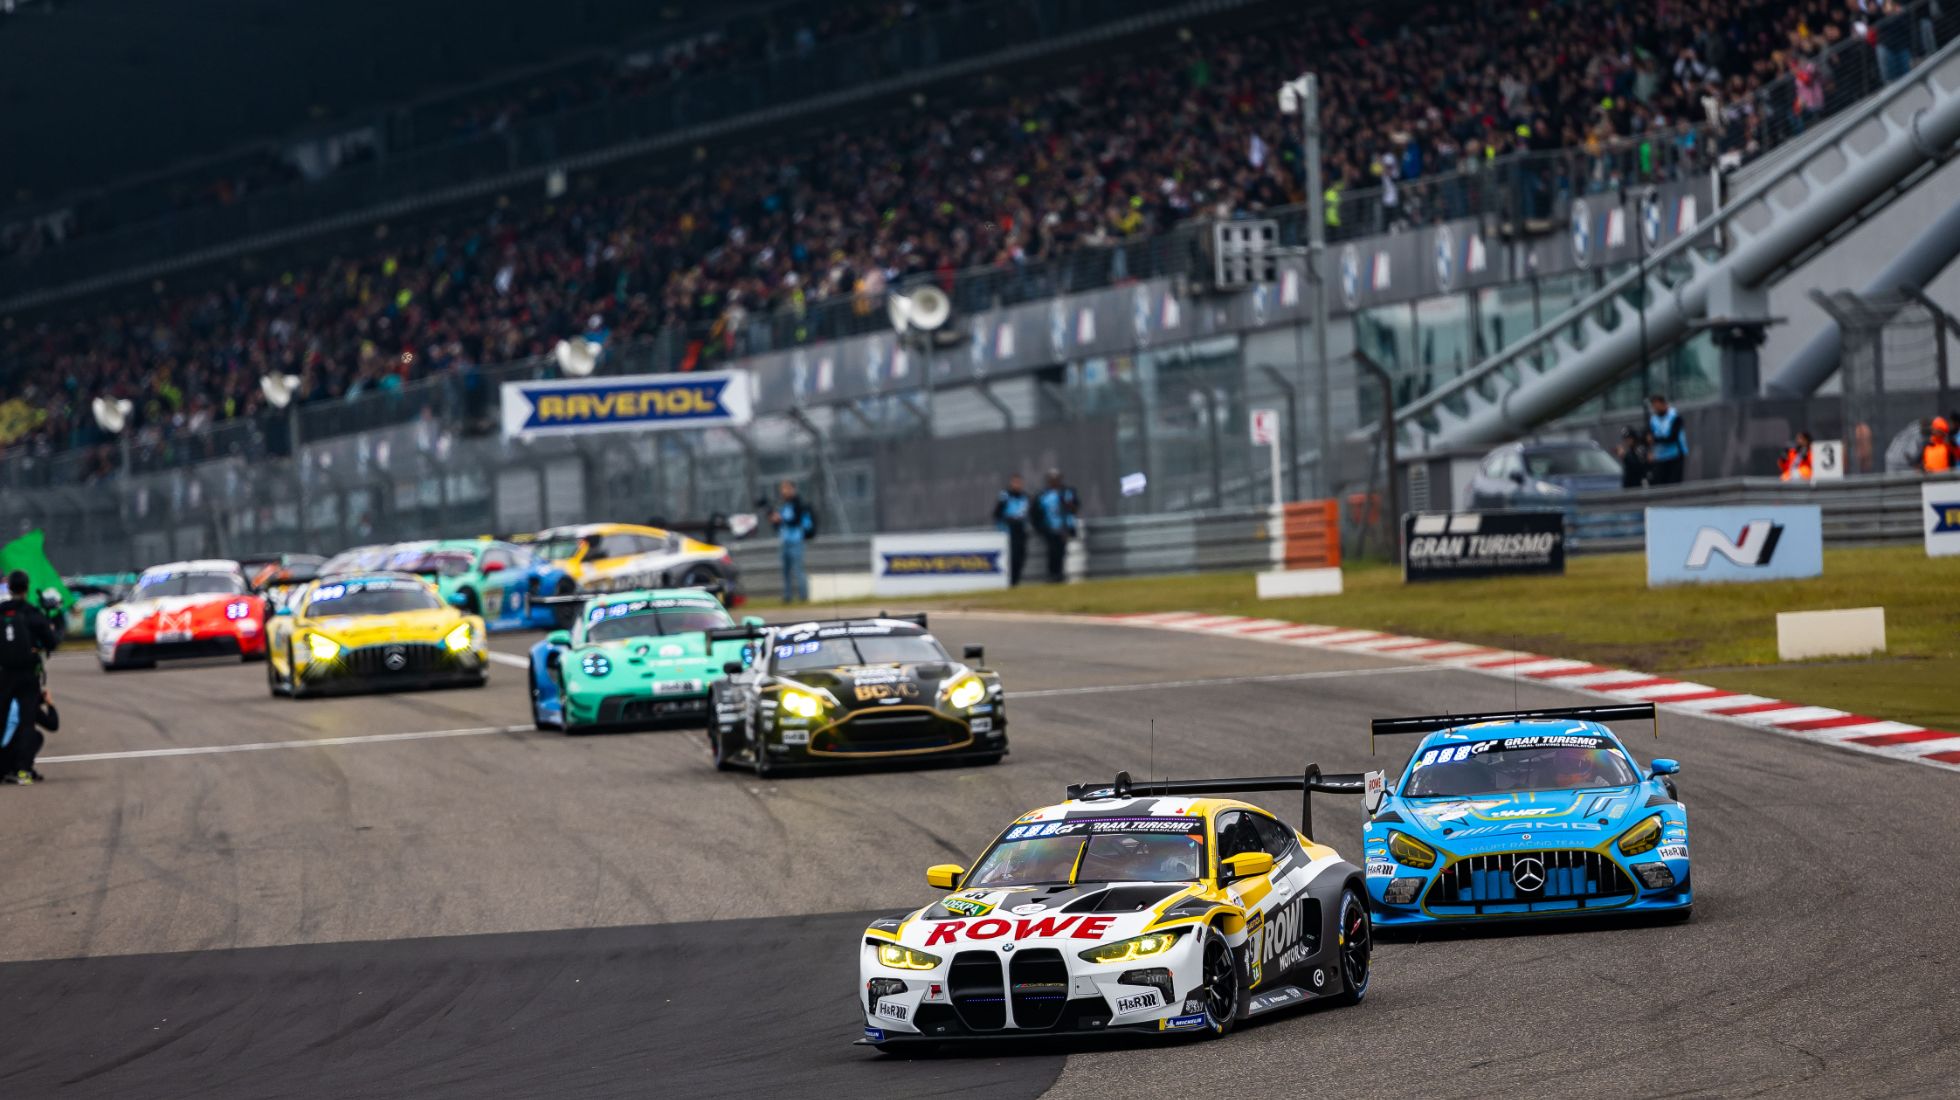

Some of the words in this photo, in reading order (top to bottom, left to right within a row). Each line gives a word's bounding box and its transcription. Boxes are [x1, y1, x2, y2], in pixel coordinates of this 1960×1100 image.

[538, 387, 716, 421] RAVENOL
[1822, 444, 1835, 470] 3
[1409, 537, 1465, 560] GRAN
[1468, 532, 1555, 556] TURISMO
[1504, 736, 1540, 746] GRAN
[1542, 736, 1598, 746] TURISMO
[1131, 821, 1194, 830] TURISMO
[1502, 822, 1601, 831] AMG
[924, 916, 1117, 946] ROWE
